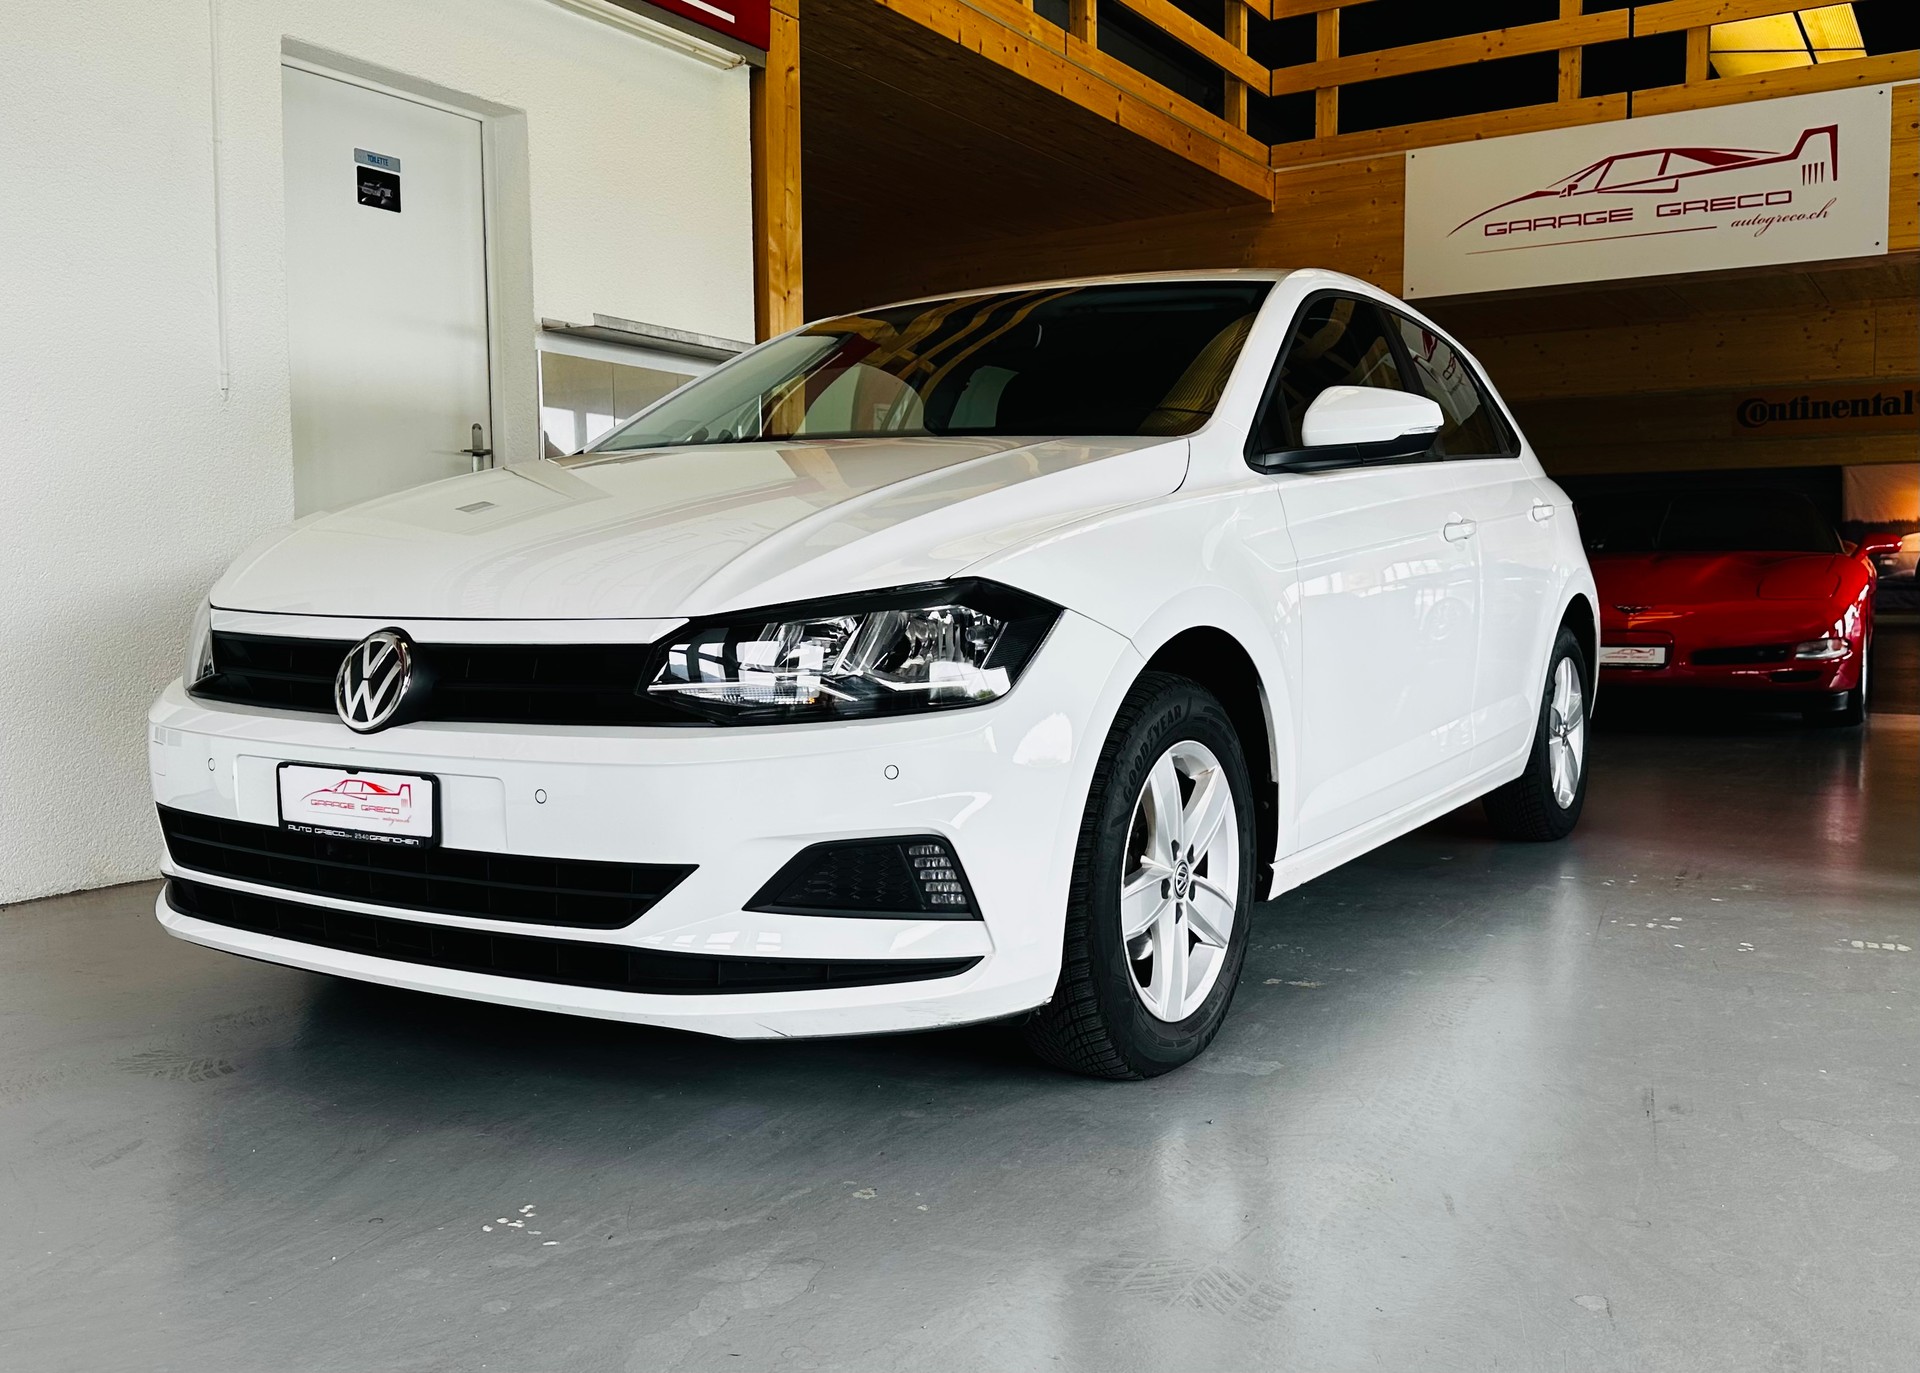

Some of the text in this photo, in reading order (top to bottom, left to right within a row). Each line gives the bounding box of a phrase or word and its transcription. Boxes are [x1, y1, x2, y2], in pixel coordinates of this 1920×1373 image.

[367, 154, 389, 166] TOILETTE
[1484, 190, 1793, 237] GARAGE GRECO
[1730, 197, 1837, 238] autogreco.ch
[1736, 389, 1914, 429] Continental
[1122, 704, 1182, 802] GOODYEAR
[311, 799, 399, 814] GARAGE GRECO
[288, 824, 312, 833] AUTO
[314, 828, 345, 837] GRECO
